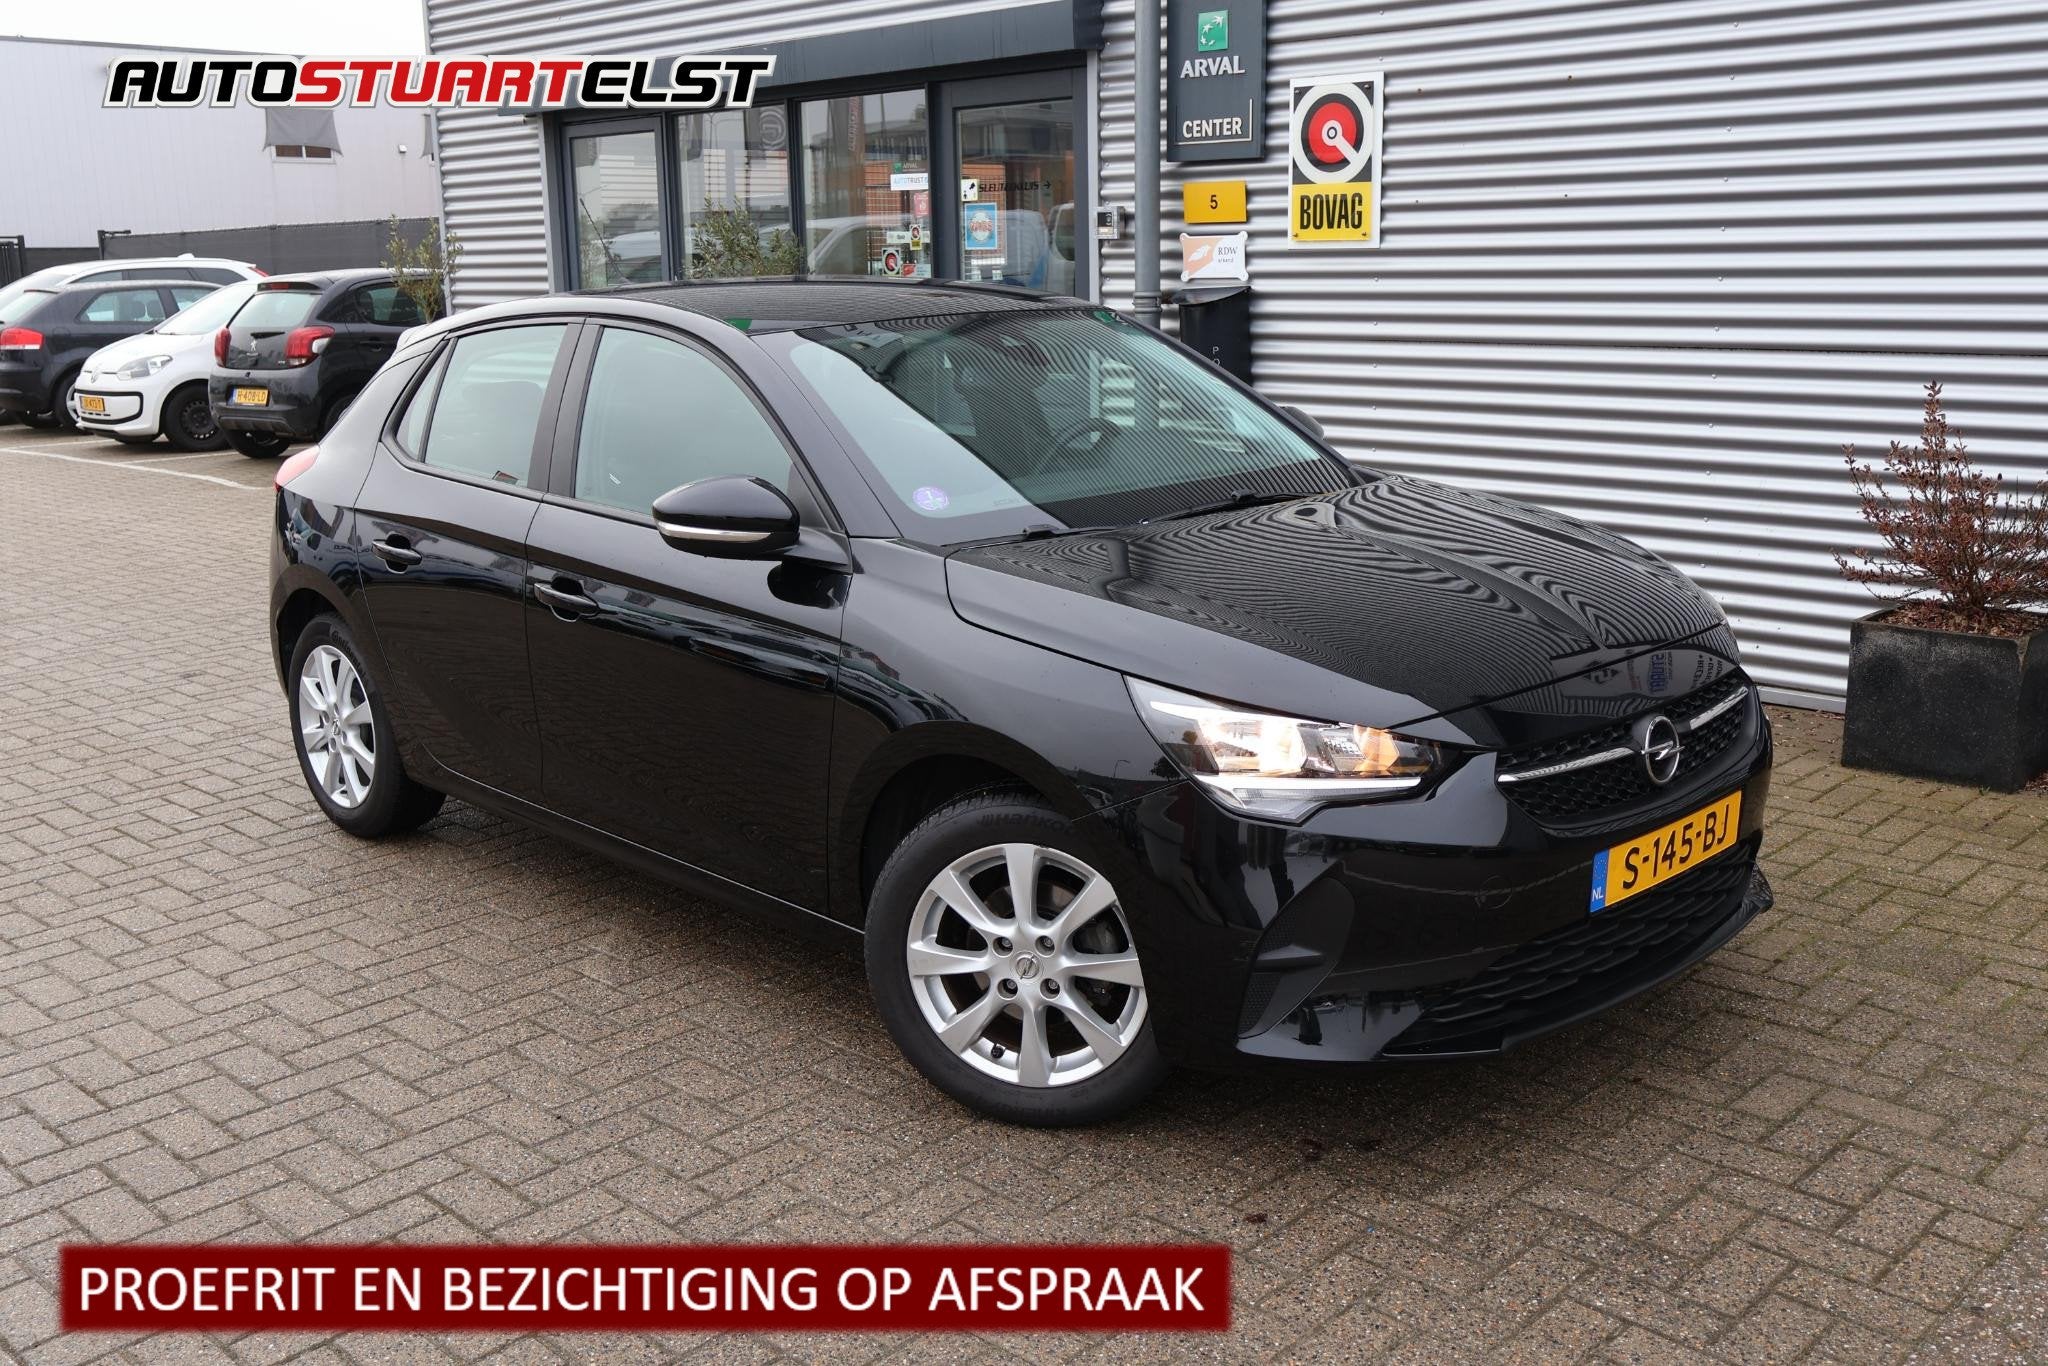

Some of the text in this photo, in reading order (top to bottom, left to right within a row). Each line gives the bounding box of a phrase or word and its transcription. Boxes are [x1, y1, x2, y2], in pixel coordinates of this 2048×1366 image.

[1180, 56, 1246, 79] ARVAL
[1182, 117, 1243, 138] CENTER
[1209, 194, 1219, 210] 5
[1299, 191, 1363, 231] BOVAG
[1217, 246, 1238, 256] RDW
[1621, 803, 1730, 890] S-145-BJ
[1591, 886, 1605, 902] NL
